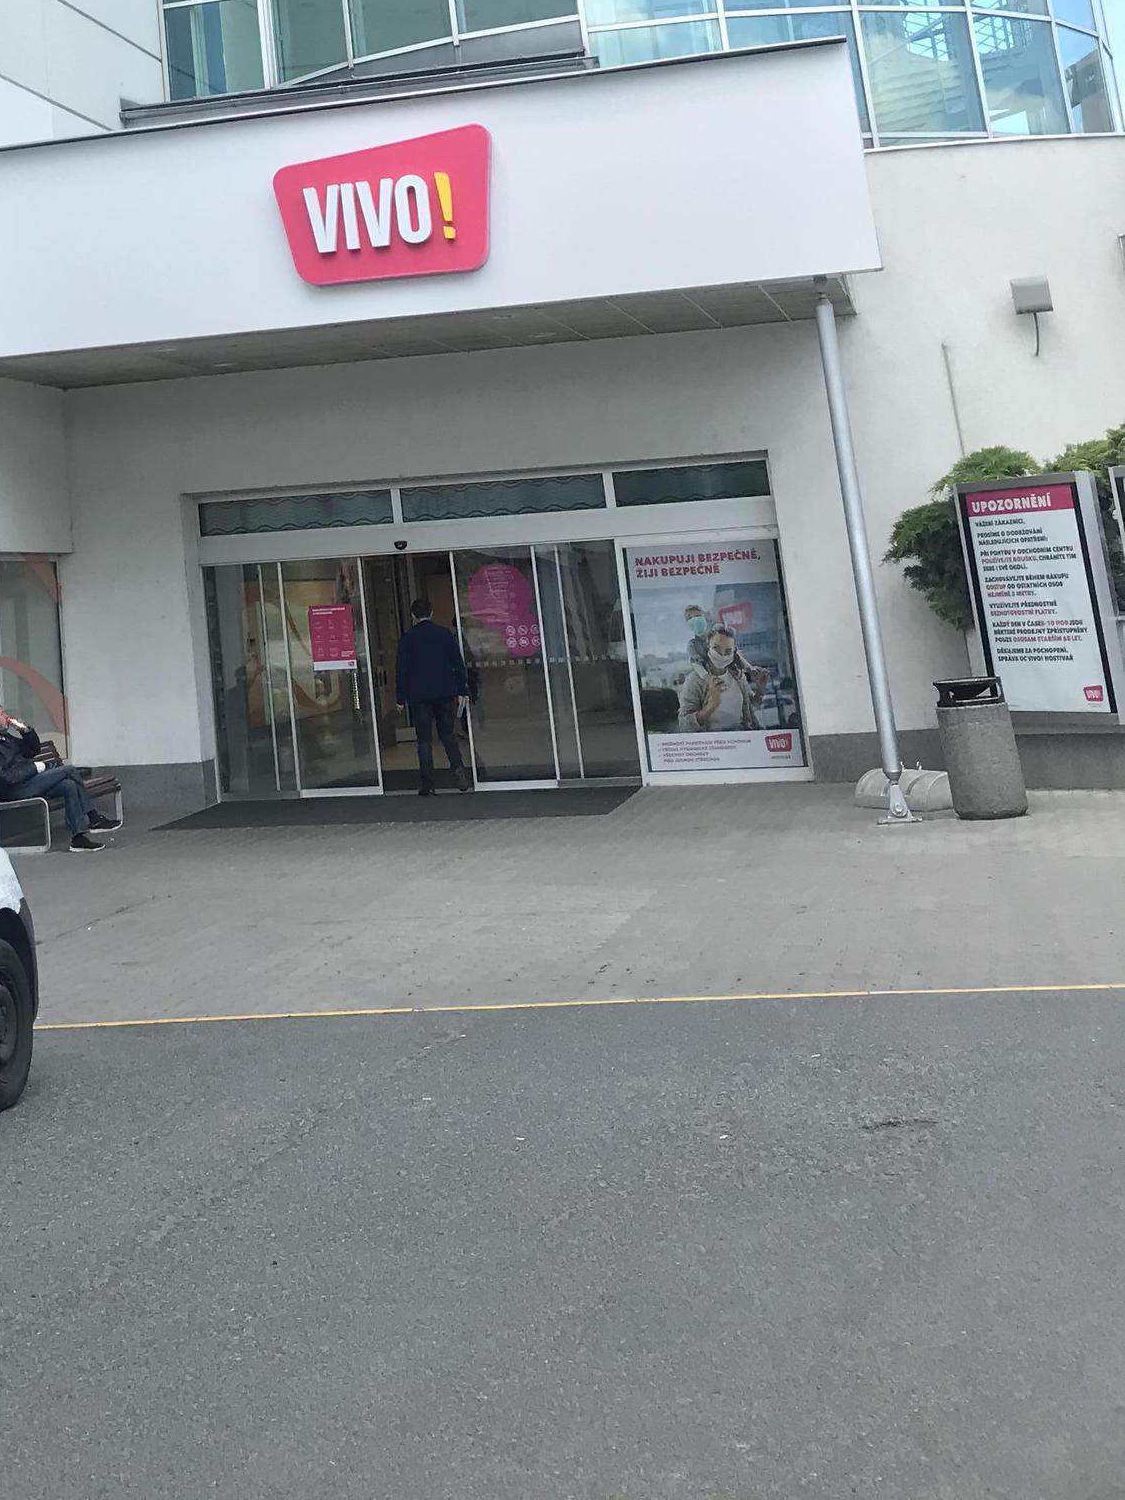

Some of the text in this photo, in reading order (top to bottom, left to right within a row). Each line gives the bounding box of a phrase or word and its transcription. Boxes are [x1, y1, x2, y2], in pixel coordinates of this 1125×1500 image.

[302, 171, 457, 253] VIVO!
[971, 492, 1051, 513] UPOZORNĚNÍ
[635, 548, 761, 566] NAKUPUJI BEZPEČNĚ,
[636, 563, 720, 578] ŽIJI BEZPEČNĚ
[768, 739, 789, 749] VIVO!
